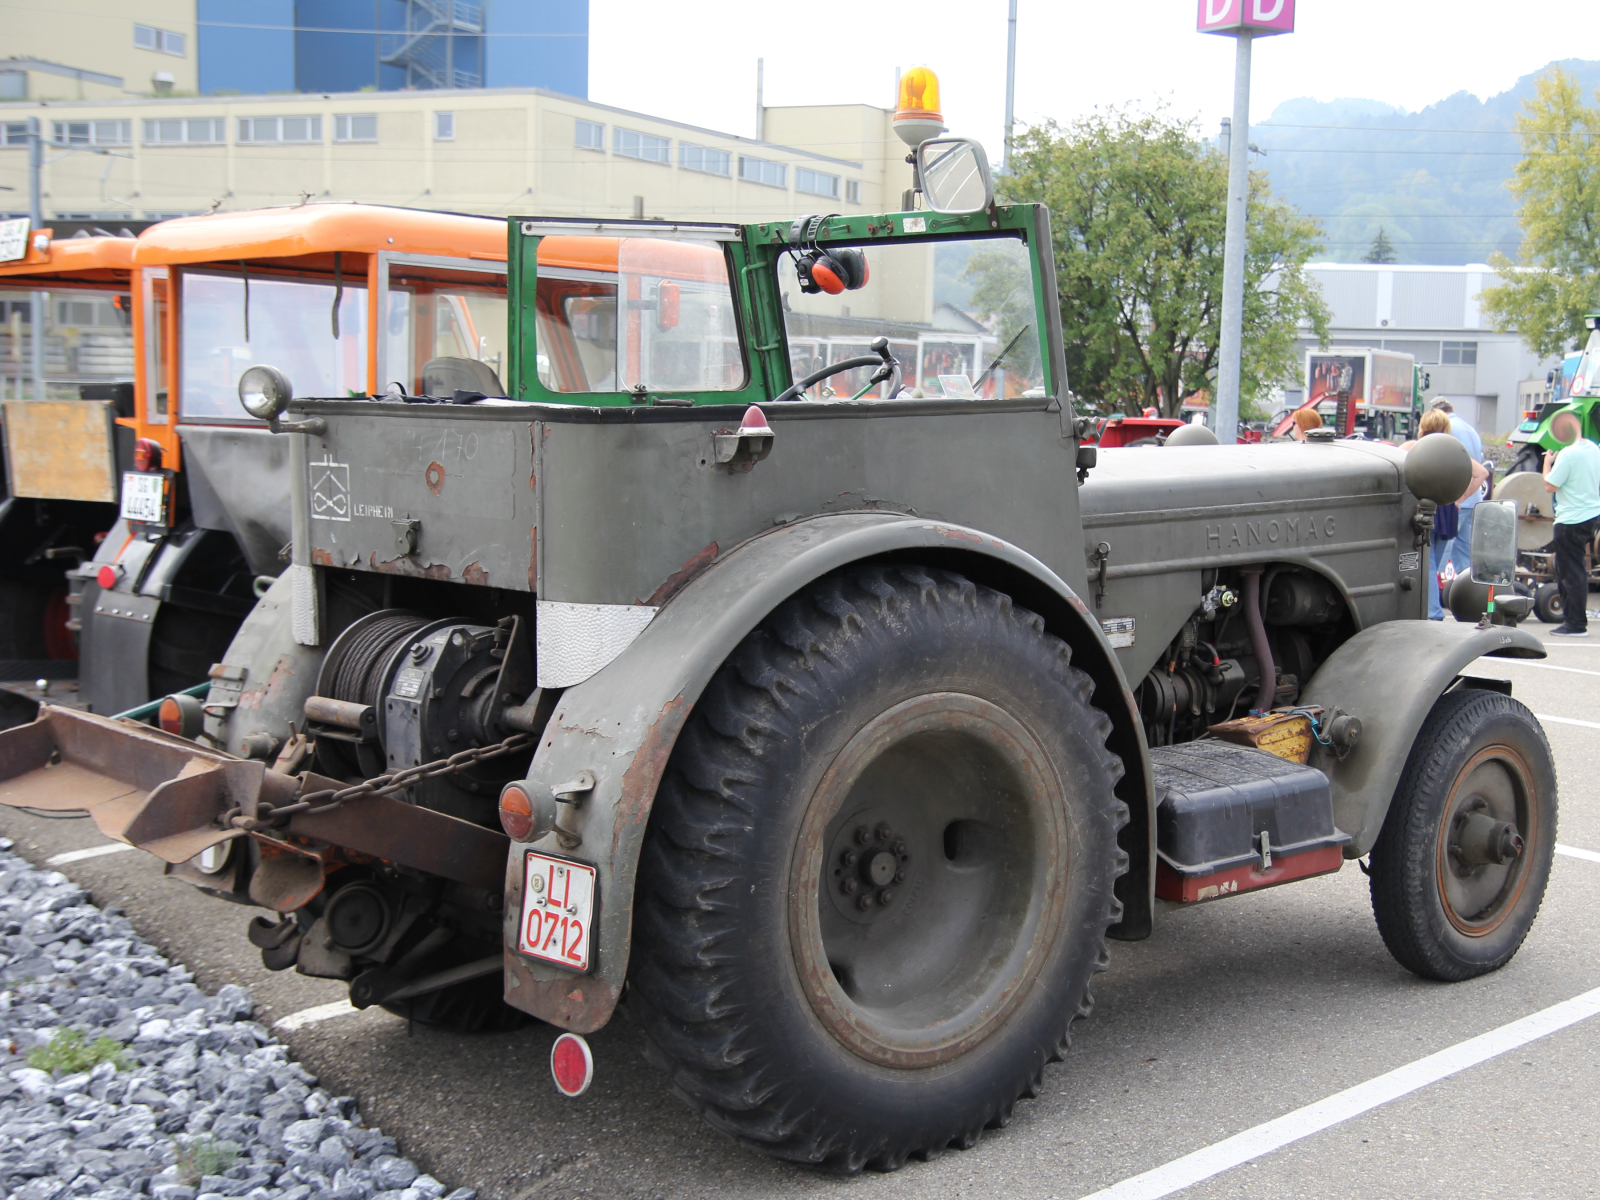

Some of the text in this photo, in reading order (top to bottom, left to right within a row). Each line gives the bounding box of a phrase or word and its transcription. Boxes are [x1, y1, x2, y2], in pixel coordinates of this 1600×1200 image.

[1206, 515, 1336, 550] HANOMAG
[547, 865, 571, 909] LI
[526, 908, 584, 962] 0712
